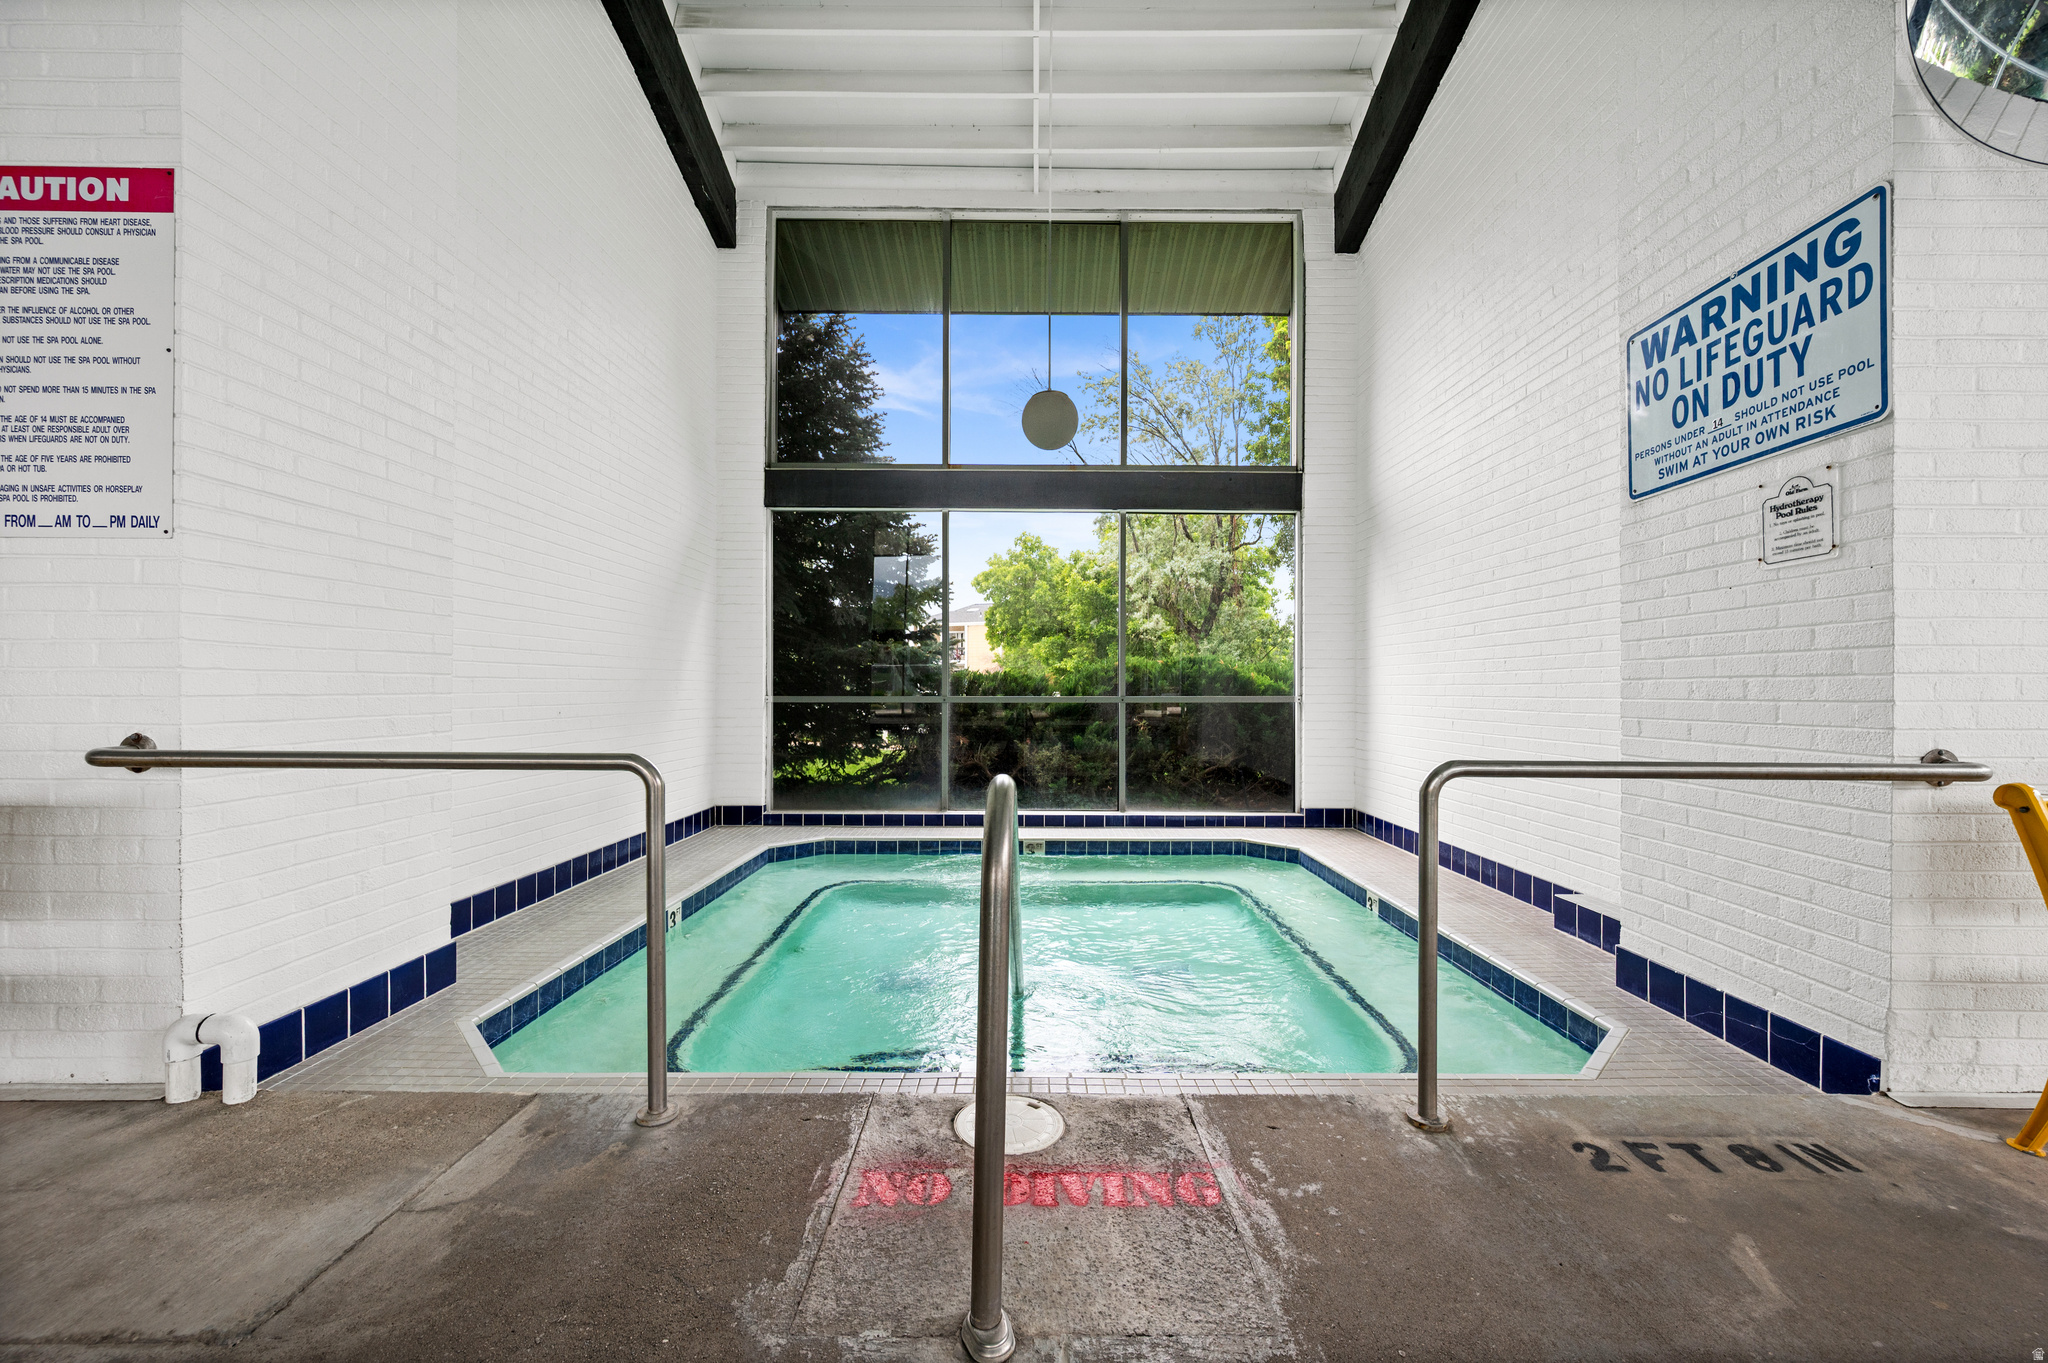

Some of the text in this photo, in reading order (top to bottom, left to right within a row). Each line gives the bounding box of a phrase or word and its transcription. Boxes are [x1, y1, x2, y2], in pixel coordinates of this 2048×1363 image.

[0, 176, 129, 202] AUTION
[4, 217, 17, 225] AND
[19, 217, 40, 225] THOSE
[42, 217, 78, 226] SUFFERING
[80, 218, 98, 226] FROM
[100, 218, 121, 226] HEART
[21, 227, 55, 235] PRESSURE
[57, 227, 83, 235] SHOULD
[85, 228, 114, 236] CONSULT
[116, 228, 121, 236] A
[123, 228, 156, 236] PHYSICIAN
[11, 237, 23, 245] SPA
[12, 256, 31, 265] FROM
[33, 257, 37, 265] A
[40, 257, 90, 265] COMMUNICABLE
[92, 257, 119, 265] DISEASE
[0, 266, 20, 275] WATER
[22, 266, 35, 275] MAY
[38, 267, 50, 275] NOT
[52, 267, 66, 275] USE
[69, 267, 80, 275] THE
[83, 267, 95, 275] SPA
[36, 277, 79, 285] MEDICATIONS
[81, 277, 107, 286] SHOULD
[10, 286, 36, 294] BEFORE
[38, 286, 59, 294] USING
[61, 286, 74, 295] THE
[1641, 218, 1862, 370] WARNING
[8, 306, 20, 314] THE
[22, 306, 56, 315] INFLUENCE
[58, 307, 67, 315] OF
[70, 307, 99, 315] ALCOHOL
[102, 307, 111, 315] OR
[113, 307, 134, 315] OTHER
[2, 316, 43, 324] SUBSTANCES
[46, 316, 71, 325] SHOULD
[74, 317, 86, 325] NOT
[88, 317, 101, 325] USE
[104, 317, 116, 325] THE
[118, 317, 130, 325] SPA
[2, 335, 15, 344] NOT
[17, 336, 30, 344] USE
[32, 336, 44, 344] THE
[47, 336, 59, 344] SPA
[61, 336, 78, 344] POOL
[1636, 262, 1873, 410] NO LIFEGUARD
[6, 355, 31, 364] SHOULD
[33, 356, 46, 364] NOT
[48, 356, 61, 364] USE
[64, 356, 76, 364] THE
[78, 356, 90, 364] SPA
[92, 356, 110, 365] POOL
[112, 357, 140, 365] WITHOUT
[1672, 334, 1813, 429] ON DUTY
[4, 385, 16, 393] NOT
[19, 385, 40, 393] SPEND
[42, 385, 60, 394] MORE
[63, 386, 80, 394] THAN
[82, 386, 89, 394] 15
[91, 386, 119, 394] MINUTES
[121, 386, 127, 394] IN
[130, 386, 142, 395] THE
[144, 386, 156, 395] SPA
[1634, 358, 1875, 461] PERSONS UNDER 14 SHOULD NOT USE POOL
[0, 415, 125, 424] THE AGE OF 14 MUST BE ACCOMPANIED
[1, 425, 130, 434] AT LEAST ONE RESPONSIBLE ADULT OVER
[1654, 386, 1840, 466] WITHOUT AN ADULT IN ATTENDANCE
[8, 435, 27, 443] WHEN
[29, 435, 68, 443] LIFEGUARDS
[70, 435, 82, 443] ARE
[84, 435, 98, 443] NOT
[100, 435, 110, 444] ON
[1658, 458, 1688, 480] SWIM
[1692, 450, 1708, 468] AT
[1712, 436, 1750, 460] YOUR
[1755, 422, 1790, 445] OWN
[1796, 404, 1837, 432] RISK
[1, 454, 131, 464] THE AGE OF FIVE YEARS ARE PROHIBITED
[6, 464, 16, 473] OR
[18, 464, 31, 473] HOT
[21, 484, 28, 493] IN
[30, 485, 55, 493] UNSAFE
[58, 485, 91, 493] ACTIVITIES
[94, 485, 103, 493] OR
[106, 485, 143, 493] HORSEPLAY
[12, 494, 29, 502] POOL
[31, 494, 38, 503] IS
[1770, 494, 1824, 512] Hydrotherapy
[1776, 505, 1818, 519] Pool Rules
[4, 514, 160, 528] FROM AM TO PM DAILY
[1368, 897, 1373, 911] 3
[670, 911, 676, 928] 3
[850, 1170, 1222, 1208] NO DIVING
